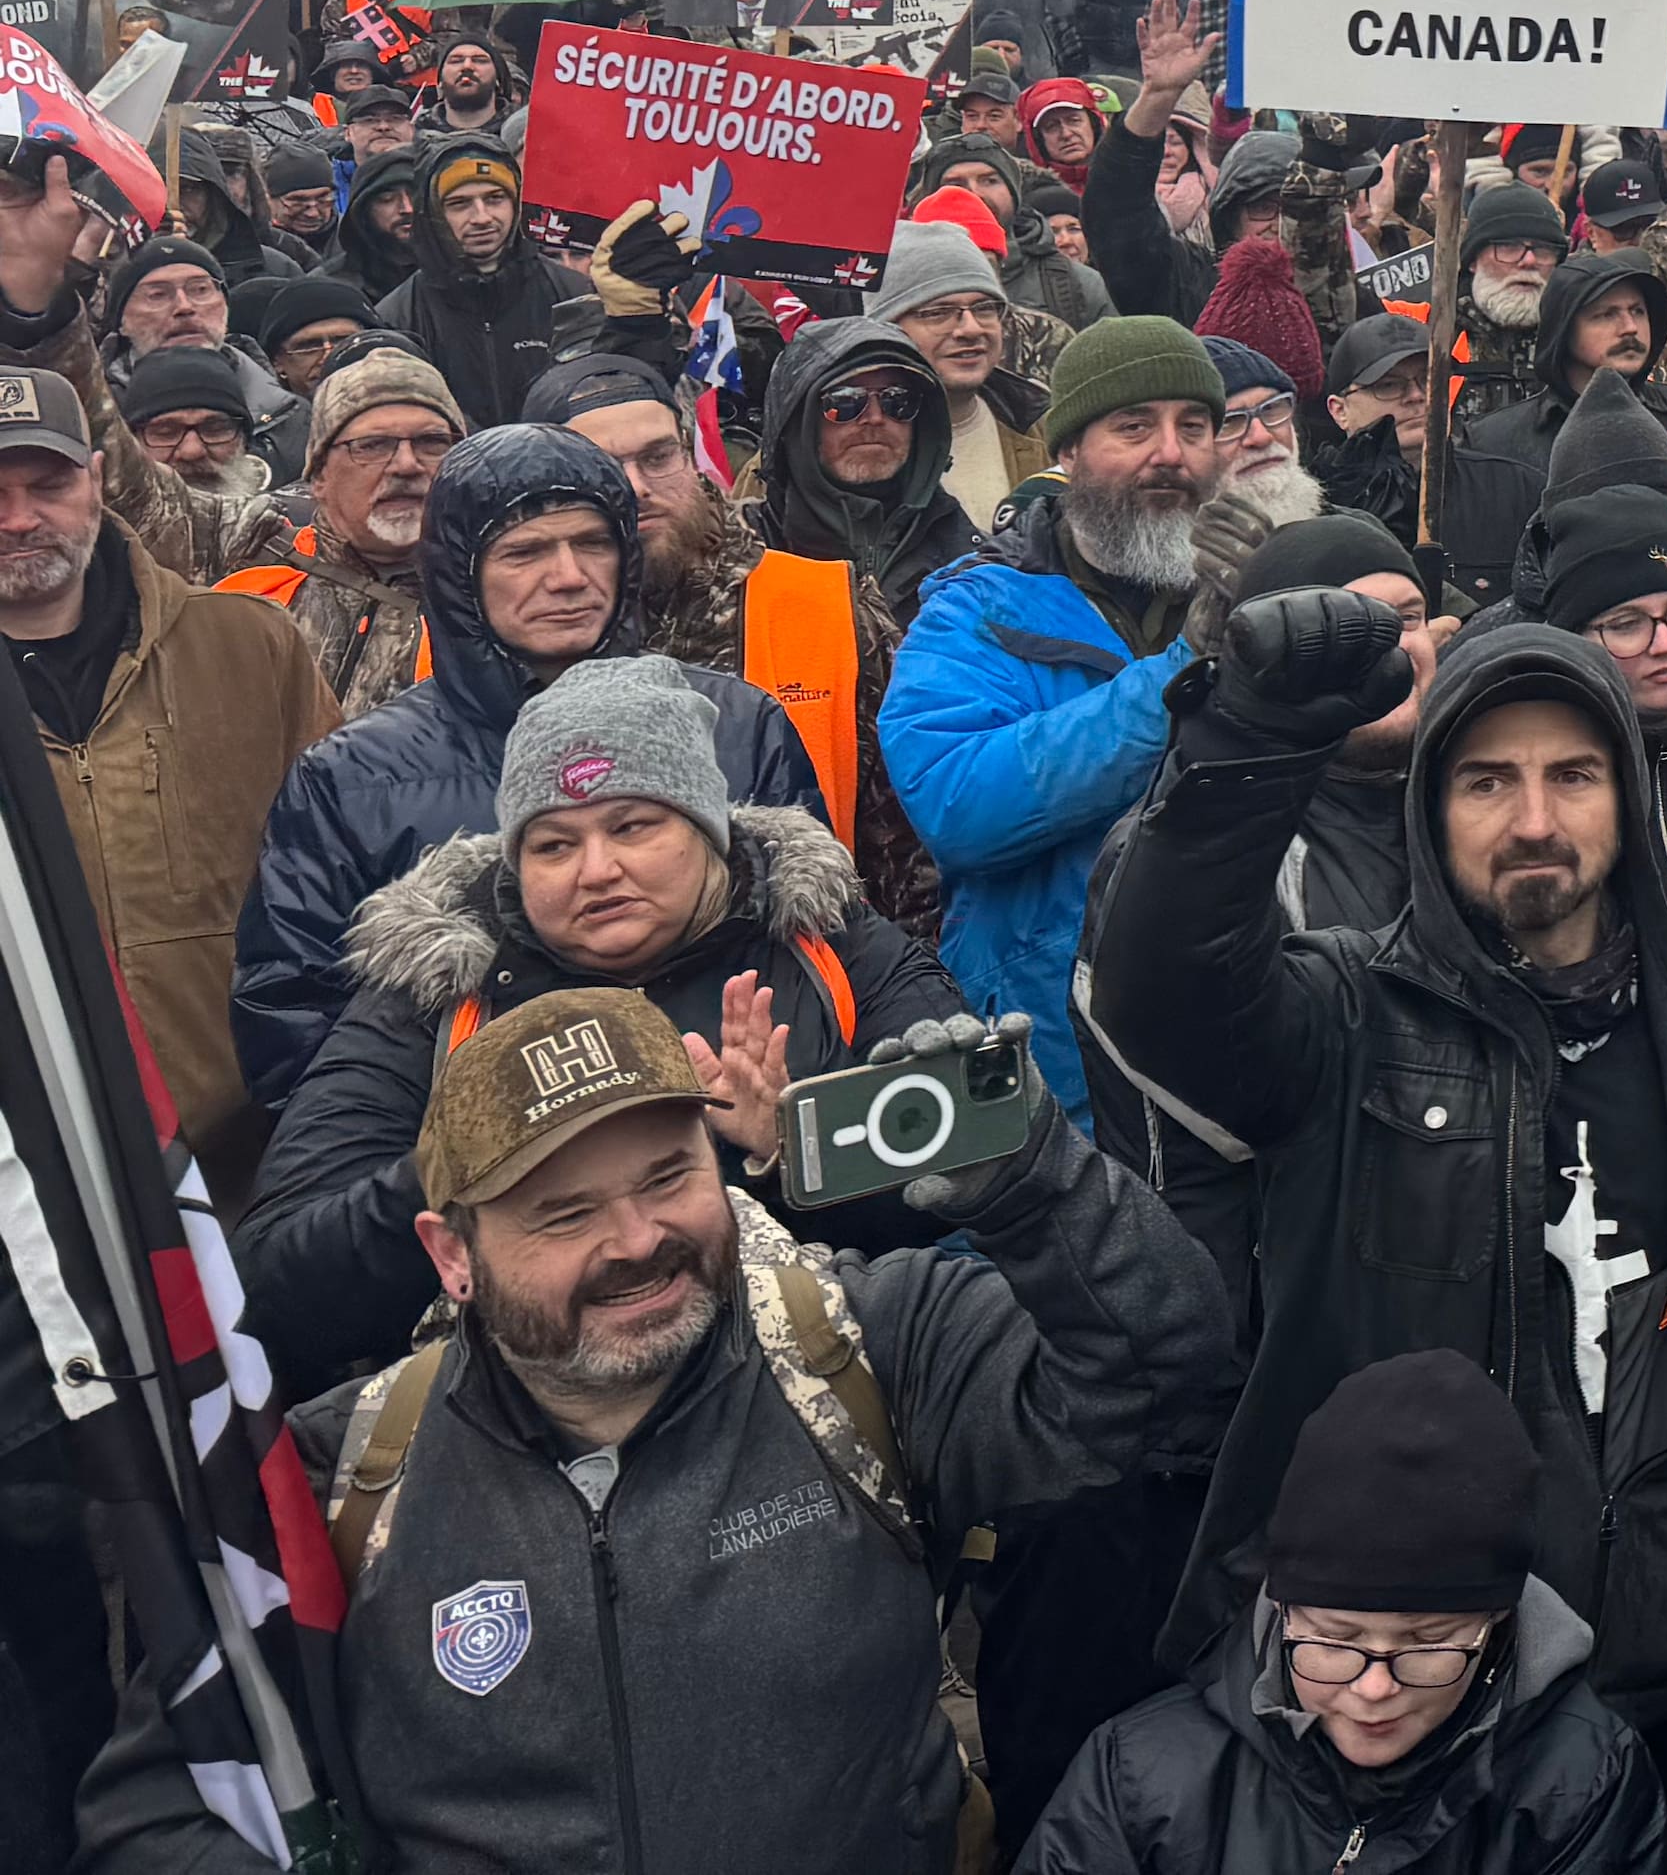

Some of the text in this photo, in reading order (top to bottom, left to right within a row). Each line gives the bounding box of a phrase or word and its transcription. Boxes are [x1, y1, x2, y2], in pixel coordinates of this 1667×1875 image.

[1347, 9, 1607, 65] CANADA!
[554, 36, 902, 133] SÉCURITÉ D'ABORD.
[625, 96, 822, 165] TOUJOURS.
[708, 1479, 827, 1537] CLUB DE TIR
[449, 1591, 514, 1621] ACCTQ
